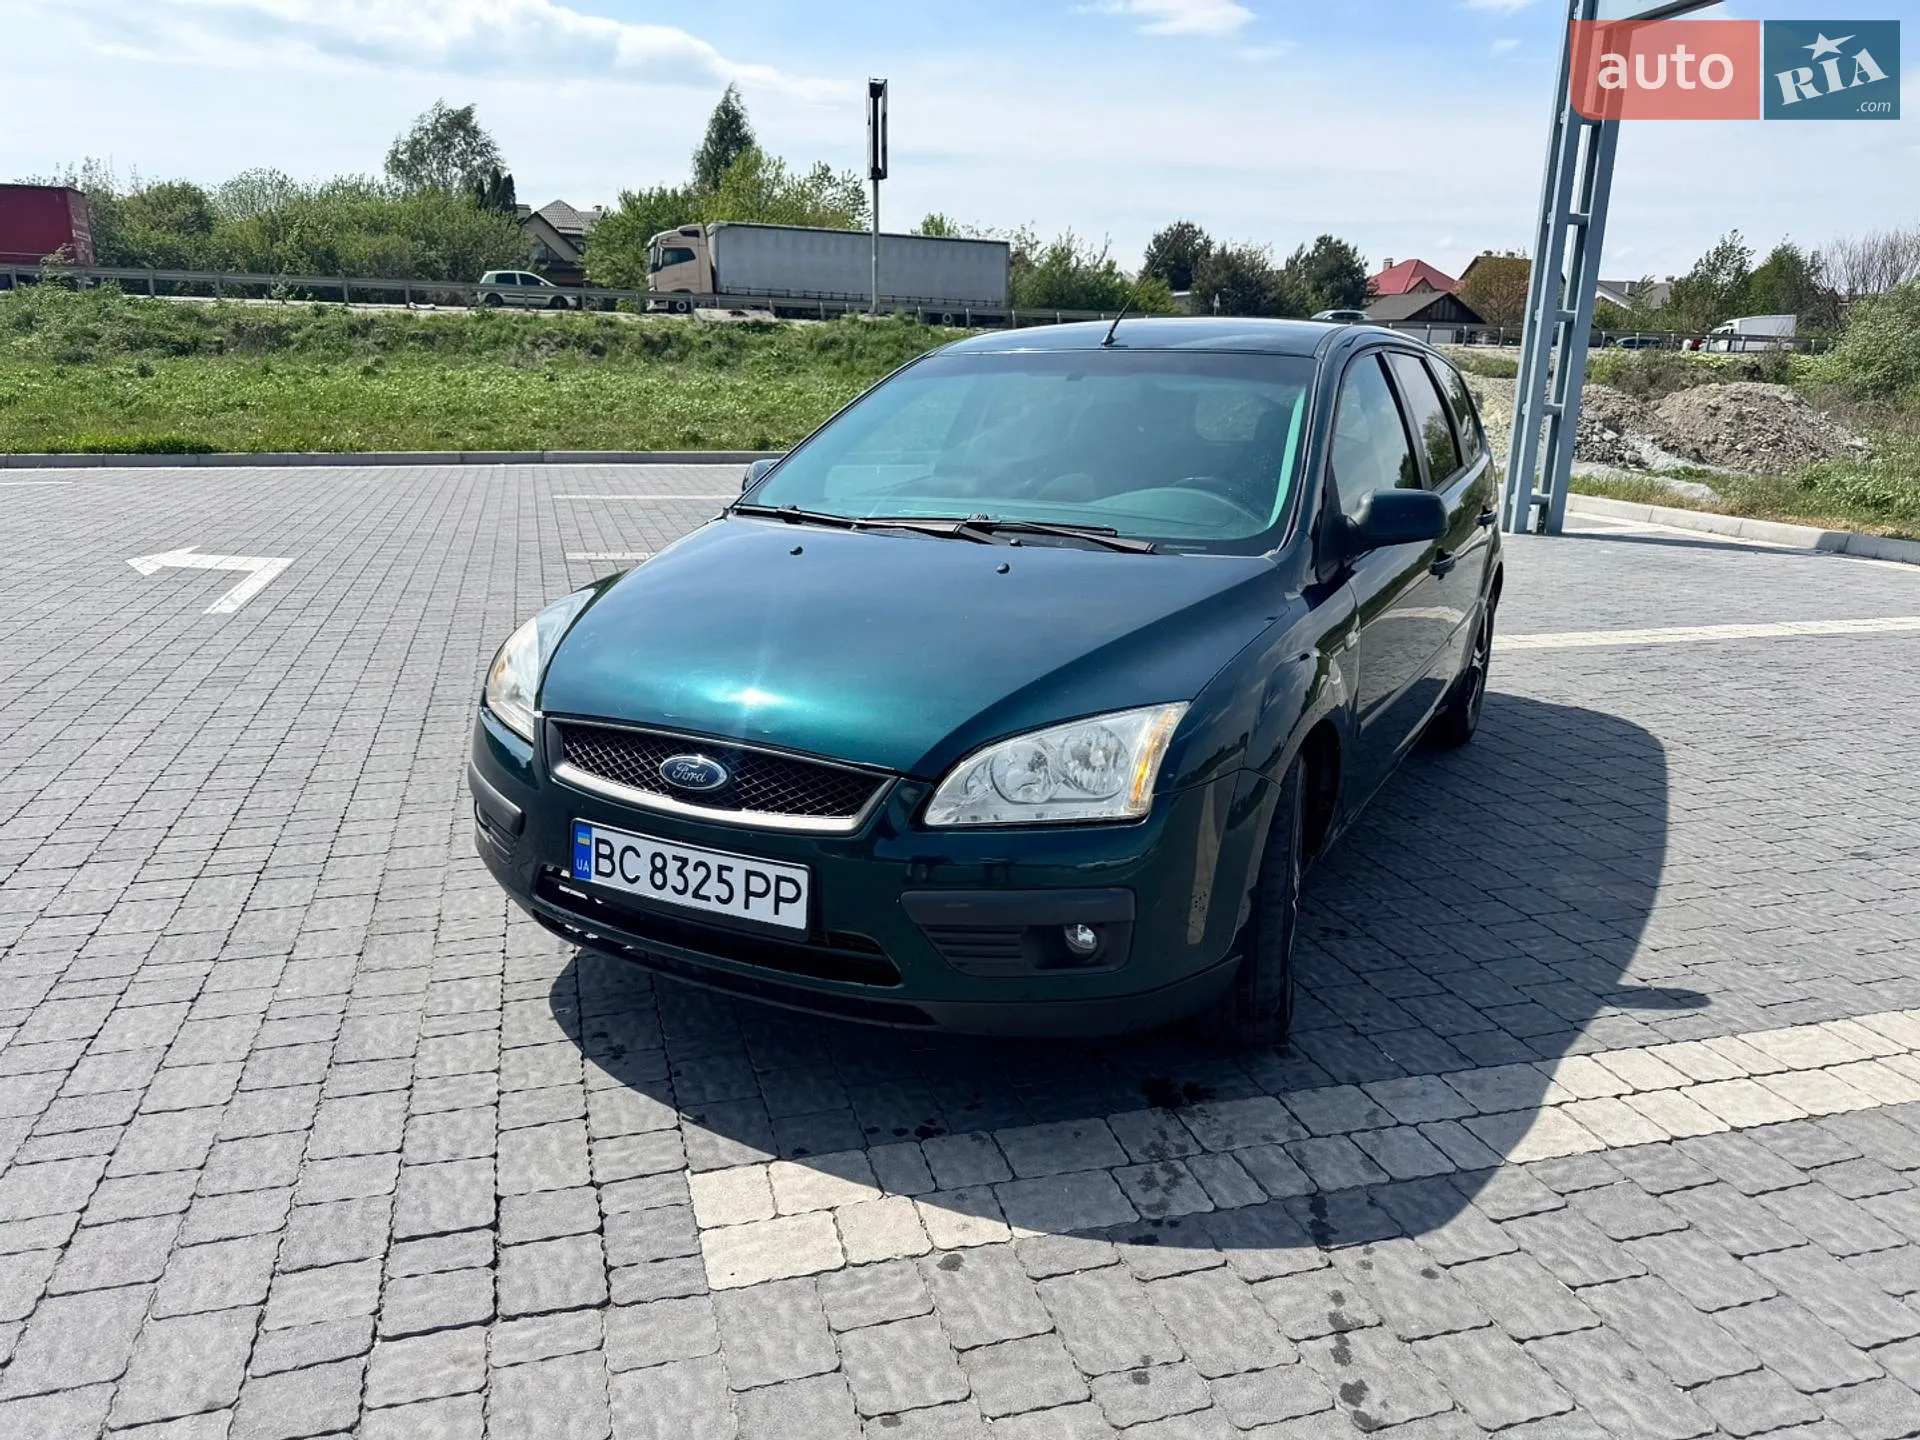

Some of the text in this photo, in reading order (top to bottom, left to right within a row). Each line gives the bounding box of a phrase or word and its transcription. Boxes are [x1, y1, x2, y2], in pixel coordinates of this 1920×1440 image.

[671, 762, 708, 783] Ford
[575, 858, 590, 873] UA
[594, 837, 802, 916] BC 8325 PP
